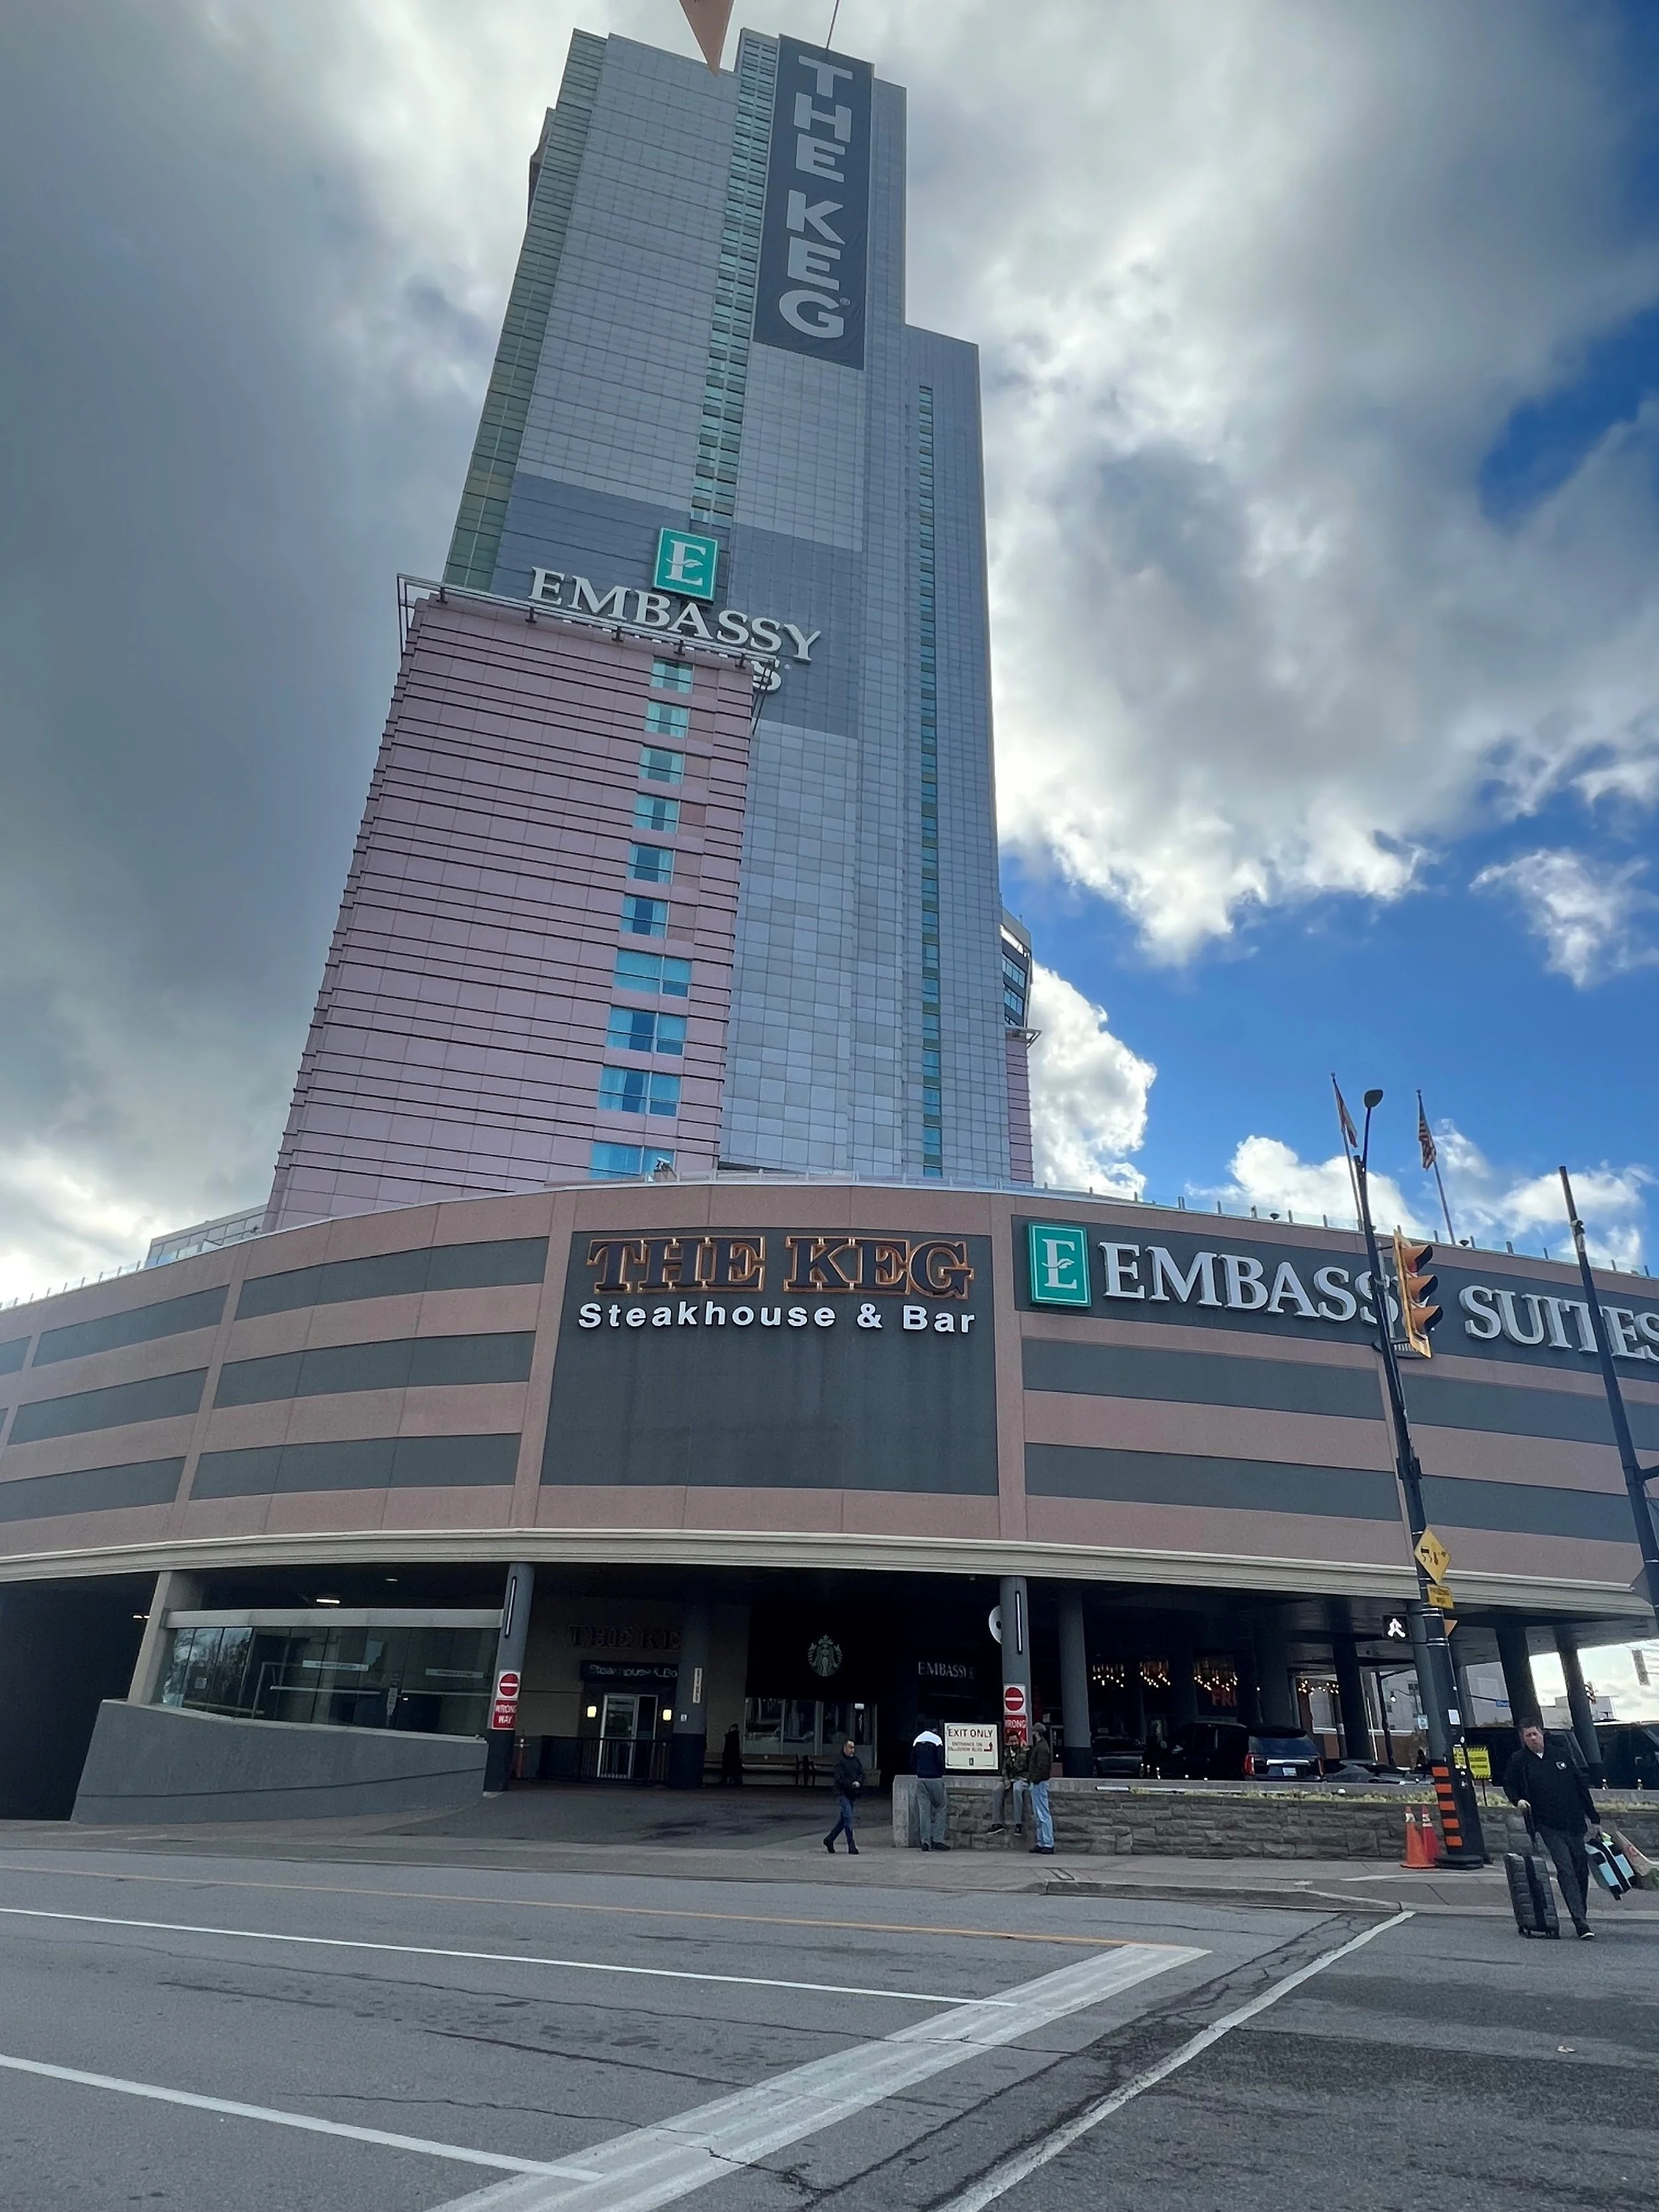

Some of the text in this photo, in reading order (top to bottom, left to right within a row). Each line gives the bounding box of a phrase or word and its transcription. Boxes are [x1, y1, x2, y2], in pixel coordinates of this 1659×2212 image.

[793, 55, 854, 183] THE
[779, 189, 846, 338] KEG
[665, 540, 707, 587] E
[528, 565, 822, 663] EMBASSY
[587, 1235, 975, 1300] THE KEG
[1041, 1238, 1078, 1290] E
[1098, 1241, 1398, 1325] EMBASS
[578, 1301, 975, 1334] Steakhouse & Bar
[569, 1625, 682, 1651] THE KE
[663, 1668, 678, 1678] Ba
[498, 1715, 512, 1724] WAY
[948, 1728, 993, 1738] EXIT ONLY
